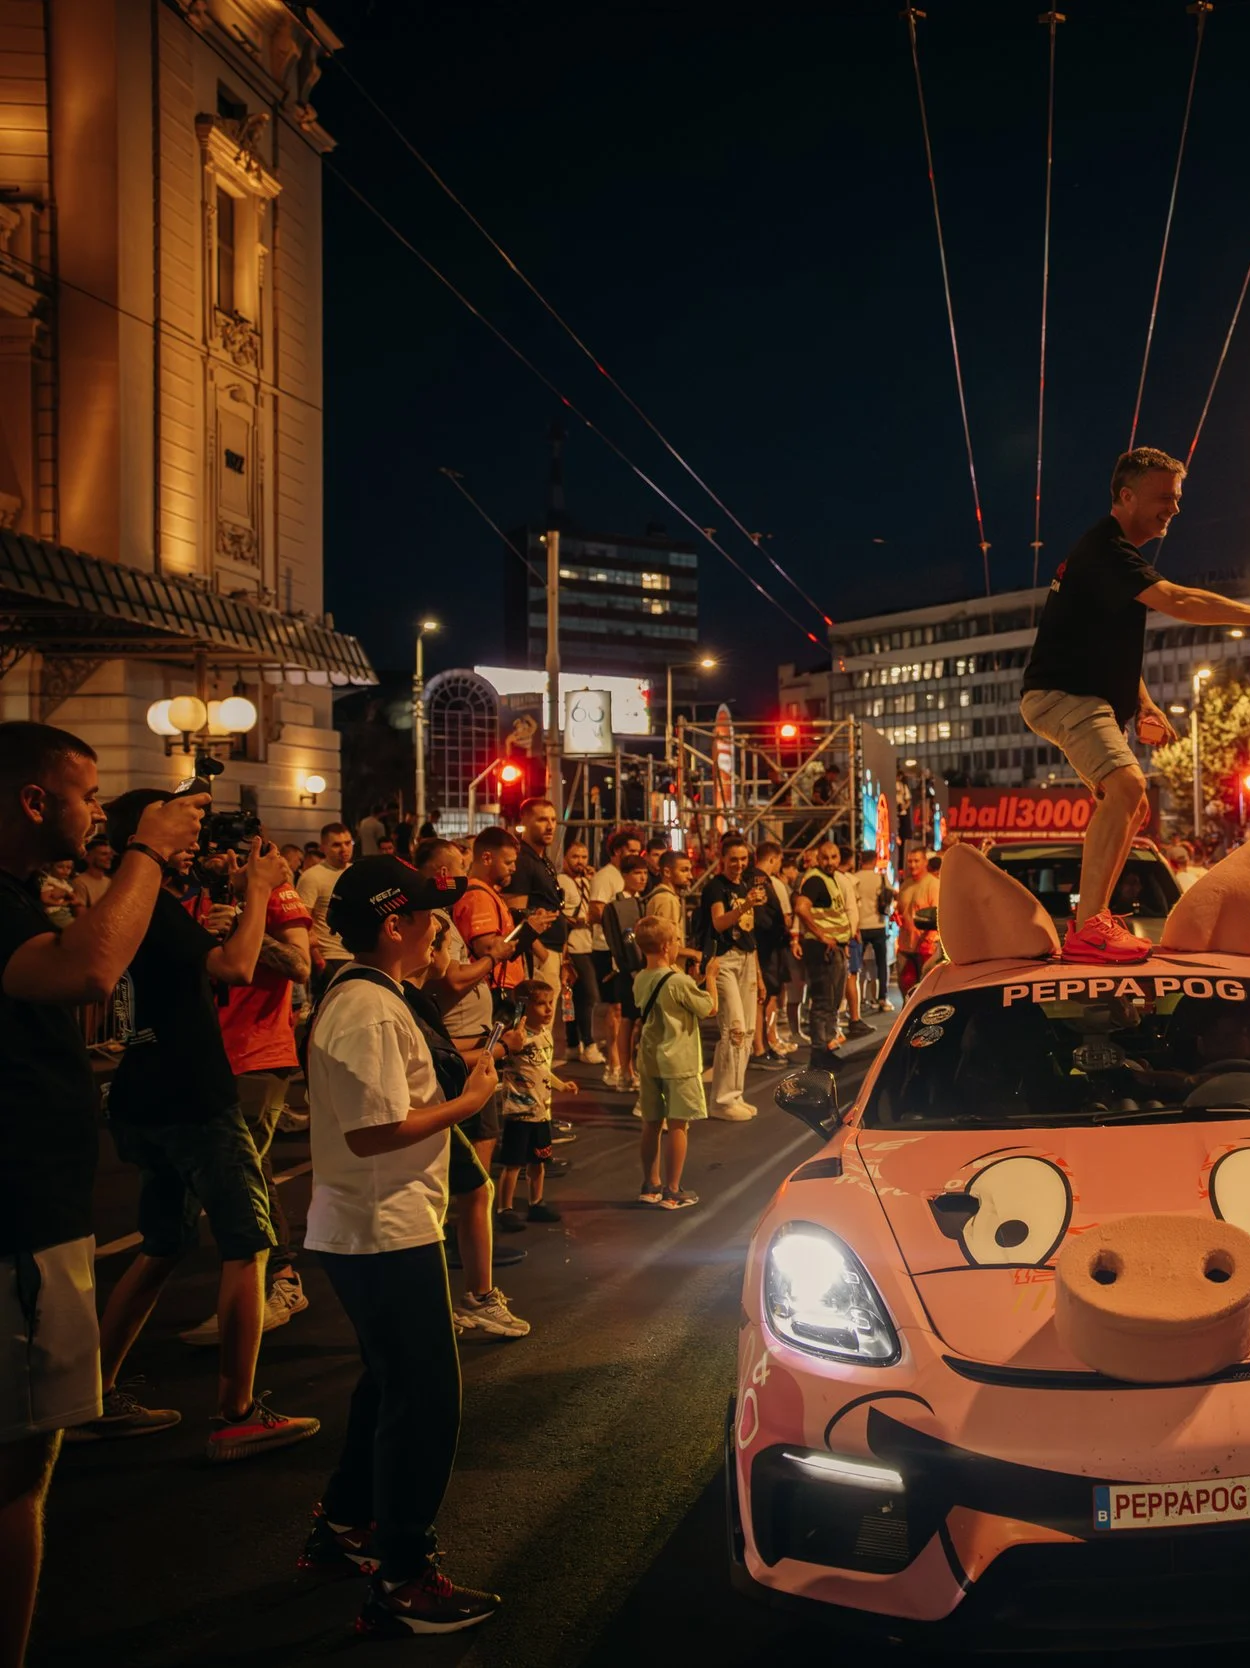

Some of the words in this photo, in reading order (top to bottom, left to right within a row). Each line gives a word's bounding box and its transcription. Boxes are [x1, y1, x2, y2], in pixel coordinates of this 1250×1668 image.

[1003, 978, 1146, 1008] PEPPA
[1154, 977, 1246, 1001] POG
[1098, 1511, 1108, 1522] B
[1115, 1484, 1248, 1520] PEPPAPOG
